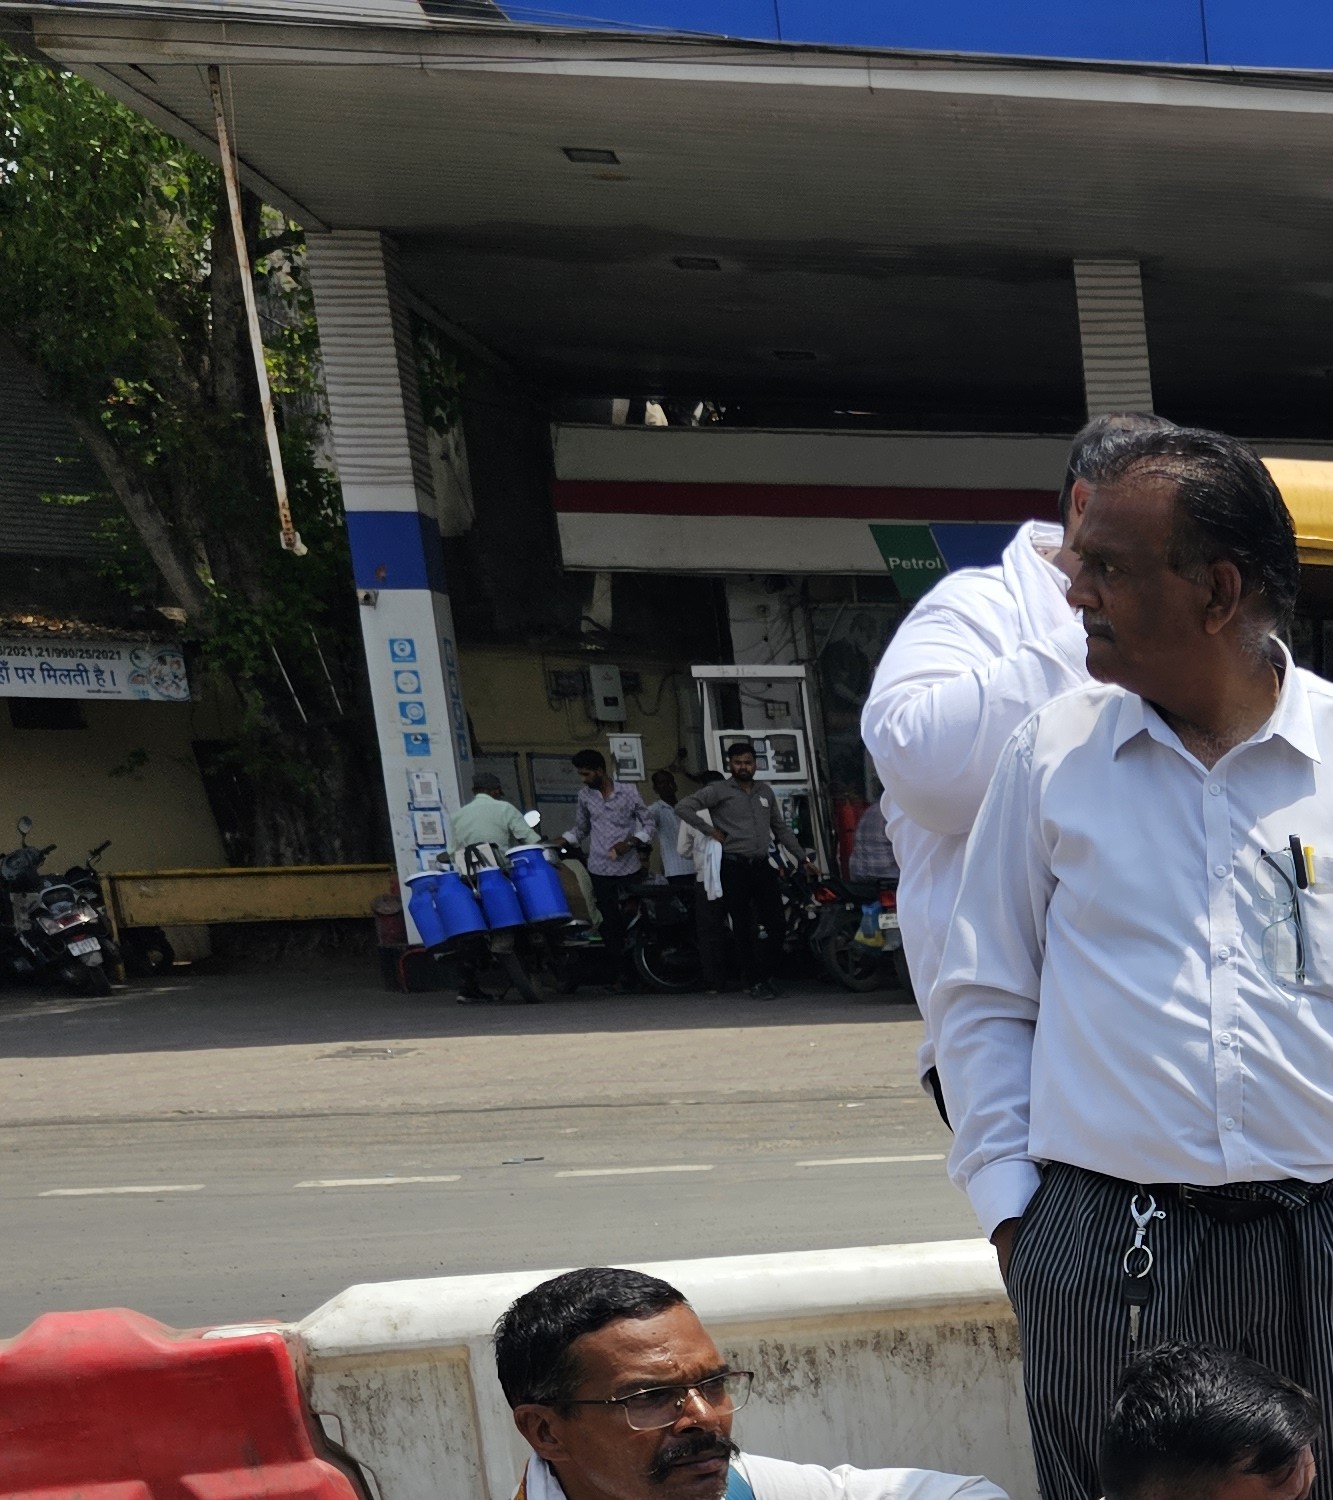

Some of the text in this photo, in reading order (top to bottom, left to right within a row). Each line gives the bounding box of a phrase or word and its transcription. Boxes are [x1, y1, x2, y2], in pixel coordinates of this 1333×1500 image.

[888, 556, 941, 570] Petrol
[14, 667, 36, 684] पर
[40, 662, 91, 686] मिलती
